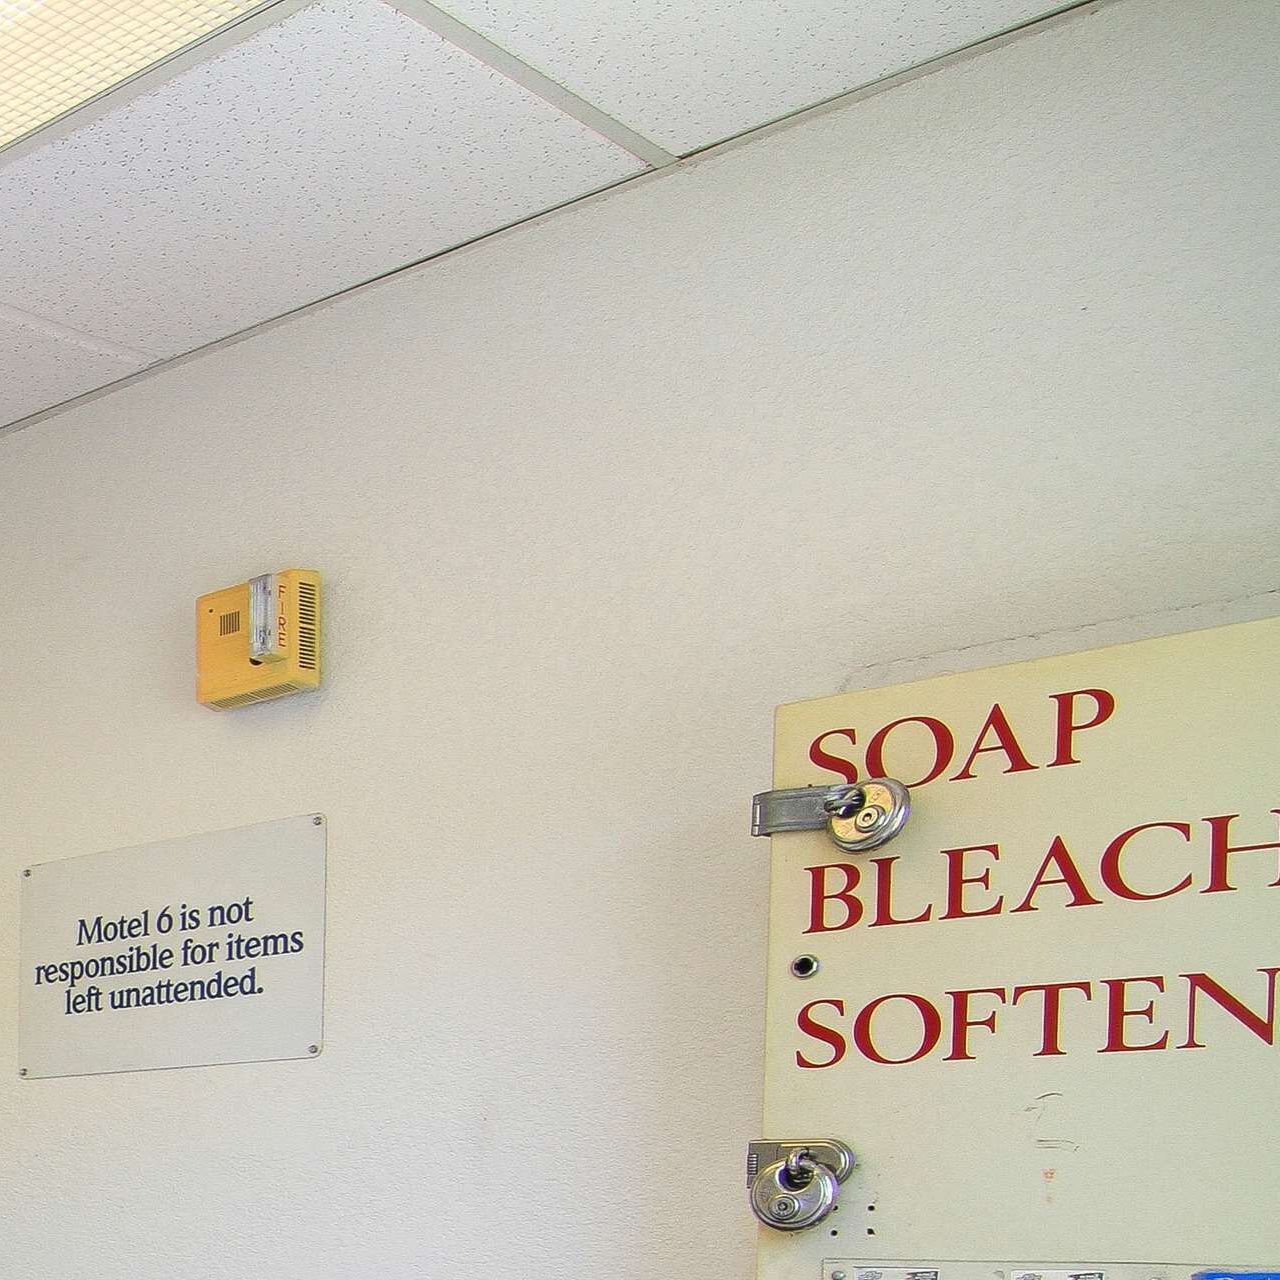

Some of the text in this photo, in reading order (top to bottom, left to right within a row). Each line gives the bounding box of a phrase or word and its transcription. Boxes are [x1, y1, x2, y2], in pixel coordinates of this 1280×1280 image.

[278, 584, 287, 648] FIRE
[809, 688, 1115, 789] SOAP
[802, 809, 1280, 934] BLEACH
[76, 896, 254, 945] Motel 6 is not
[34, 931, 304, 987] responsible for items
[64, 966, 264, 1015] left unattended.
[796, 967, 1280, 1069] SOFTEN
